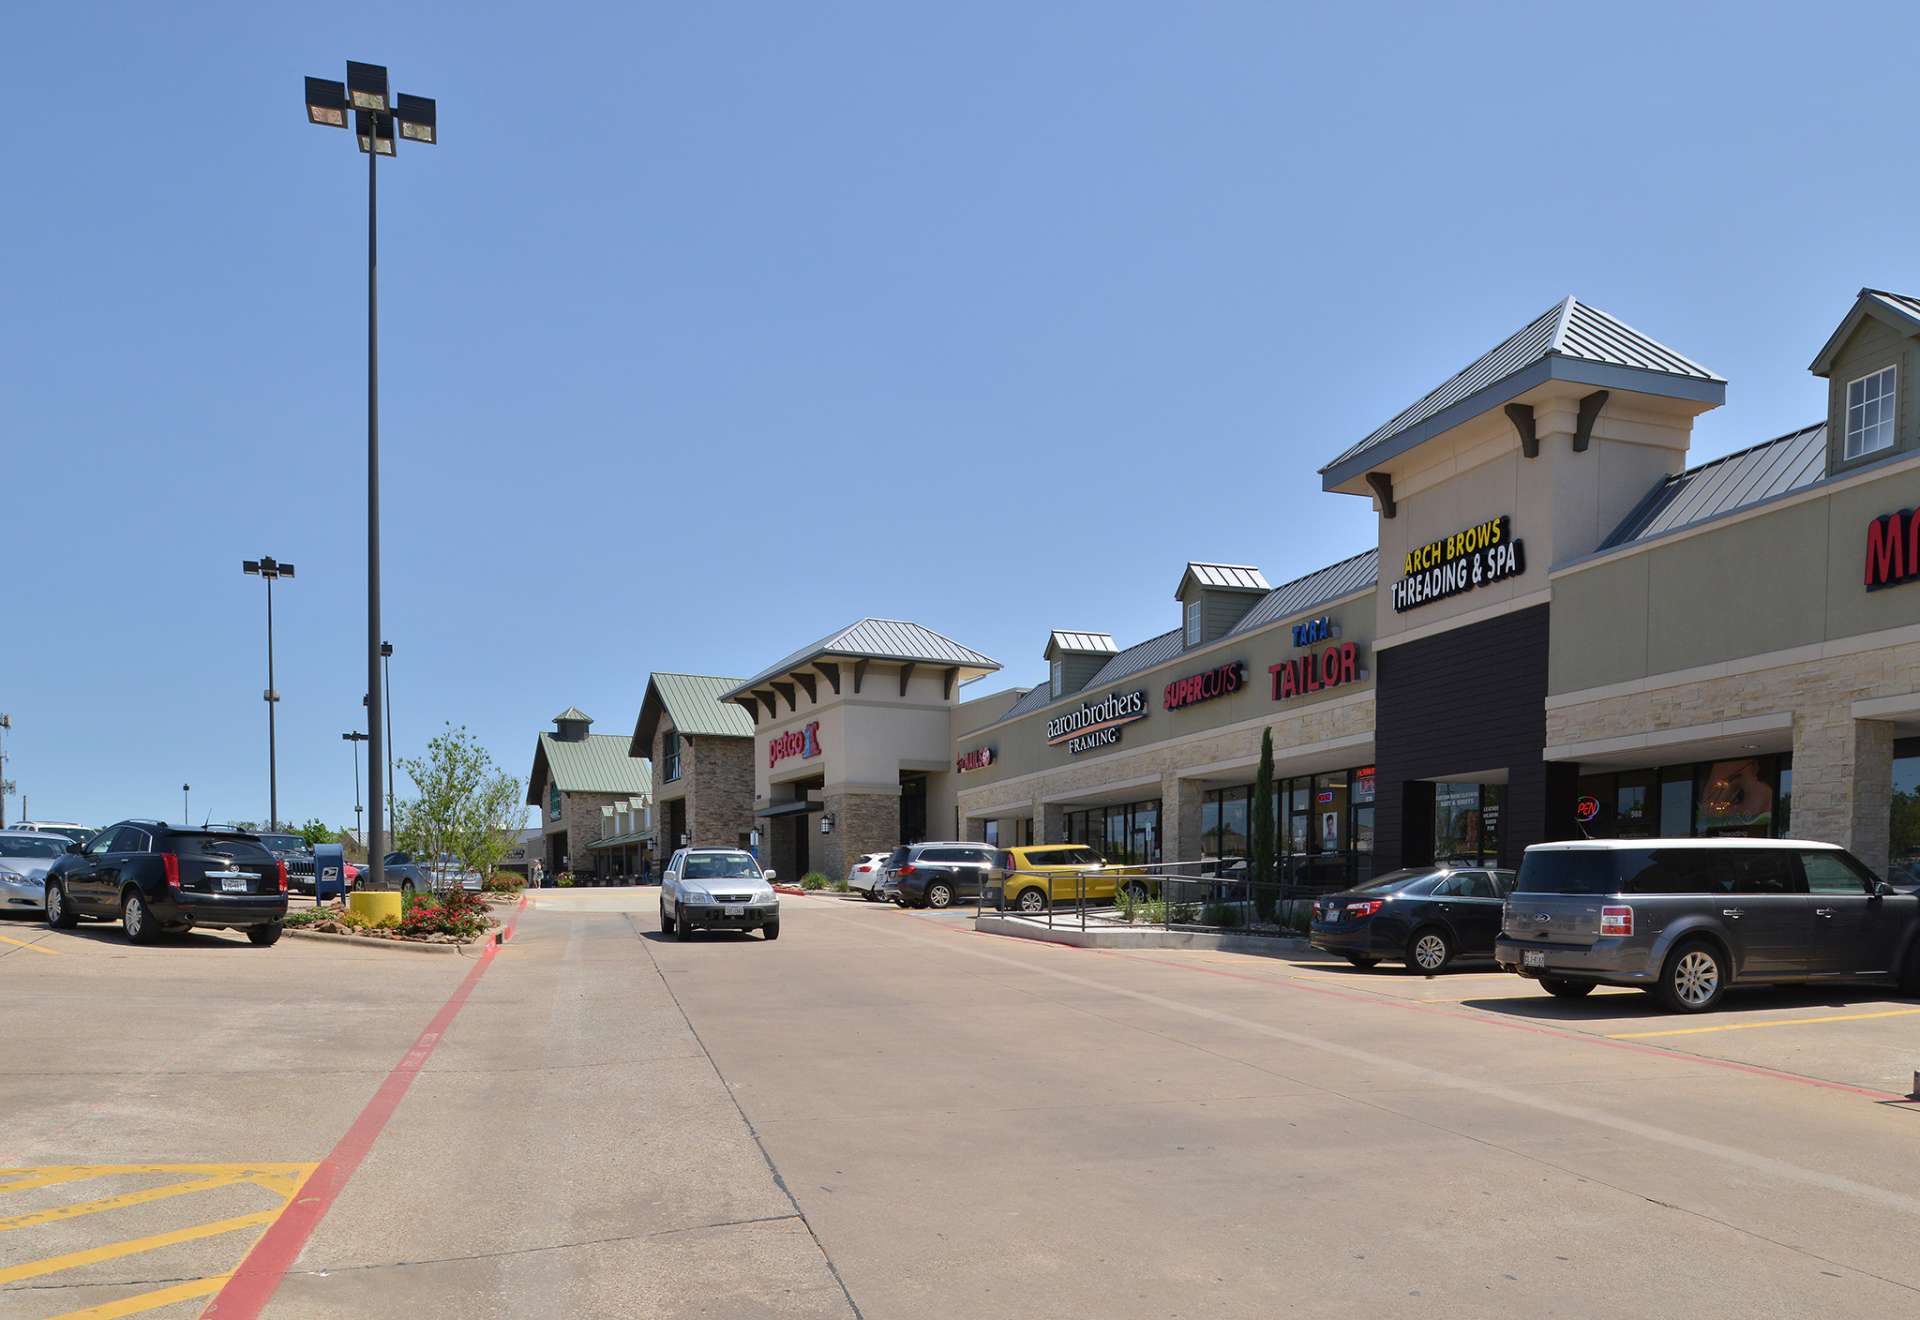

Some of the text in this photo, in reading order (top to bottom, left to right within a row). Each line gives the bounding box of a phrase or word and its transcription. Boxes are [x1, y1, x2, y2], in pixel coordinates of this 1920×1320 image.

[1404, 518, 1501, 575] ARCH BROWS
[1864, 506, 1920, 587] M
[1391, 542, 1516, 610] THREADING & SPA
[1292, 616, 1329, 647] TARA
[1163, 662, 1240, 710] SUPERCUTS
[1268, 642, 1361, 700] TAILOR
[1047, 691, 1141, 738] aaronbrothers
[769, 731, 804, 768] petco
[1068, 727, 1117, 754] FRAMING
[1577, 802, 1597, 816] PEN
